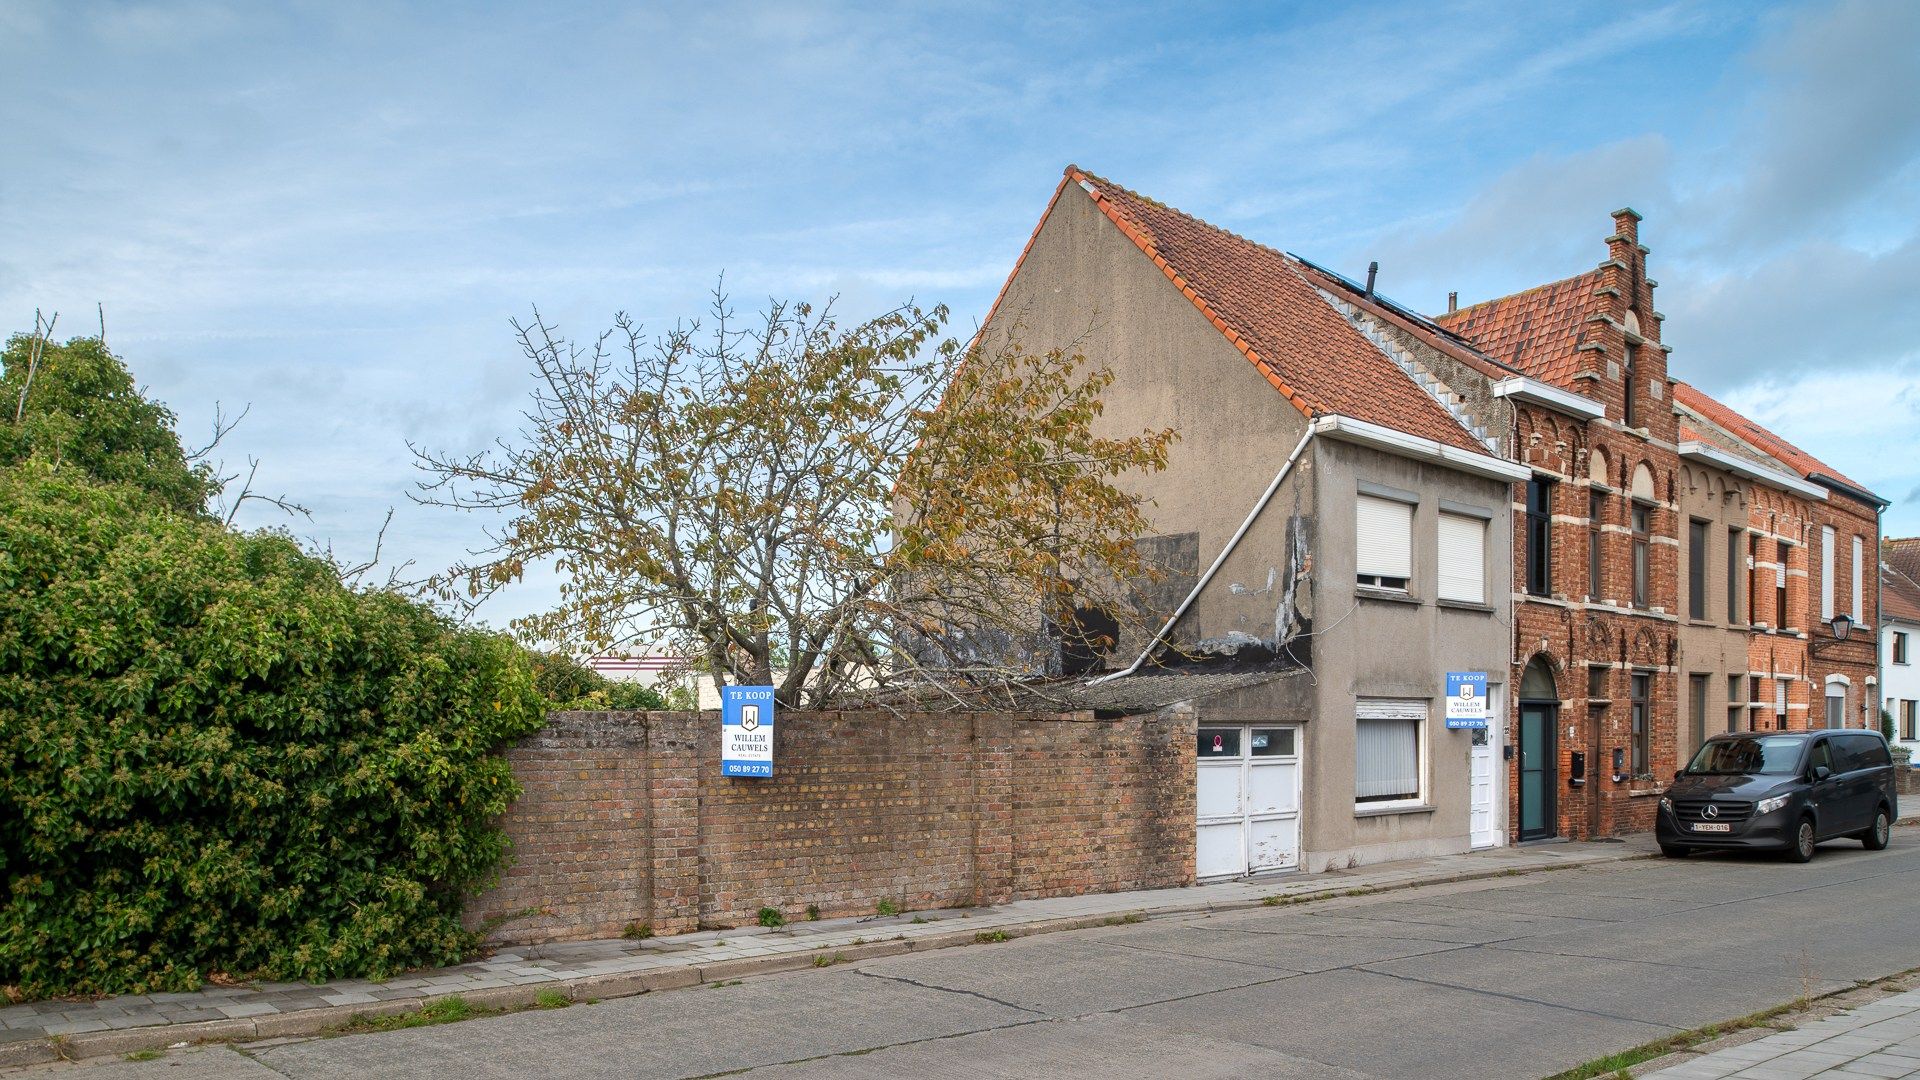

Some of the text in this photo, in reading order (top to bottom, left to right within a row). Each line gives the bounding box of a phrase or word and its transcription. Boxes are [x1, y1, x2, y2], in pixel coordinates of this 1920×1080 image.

[730, 692, 772, 700] TE KOOP
[731, 744, 768, 752] CAUWELS
